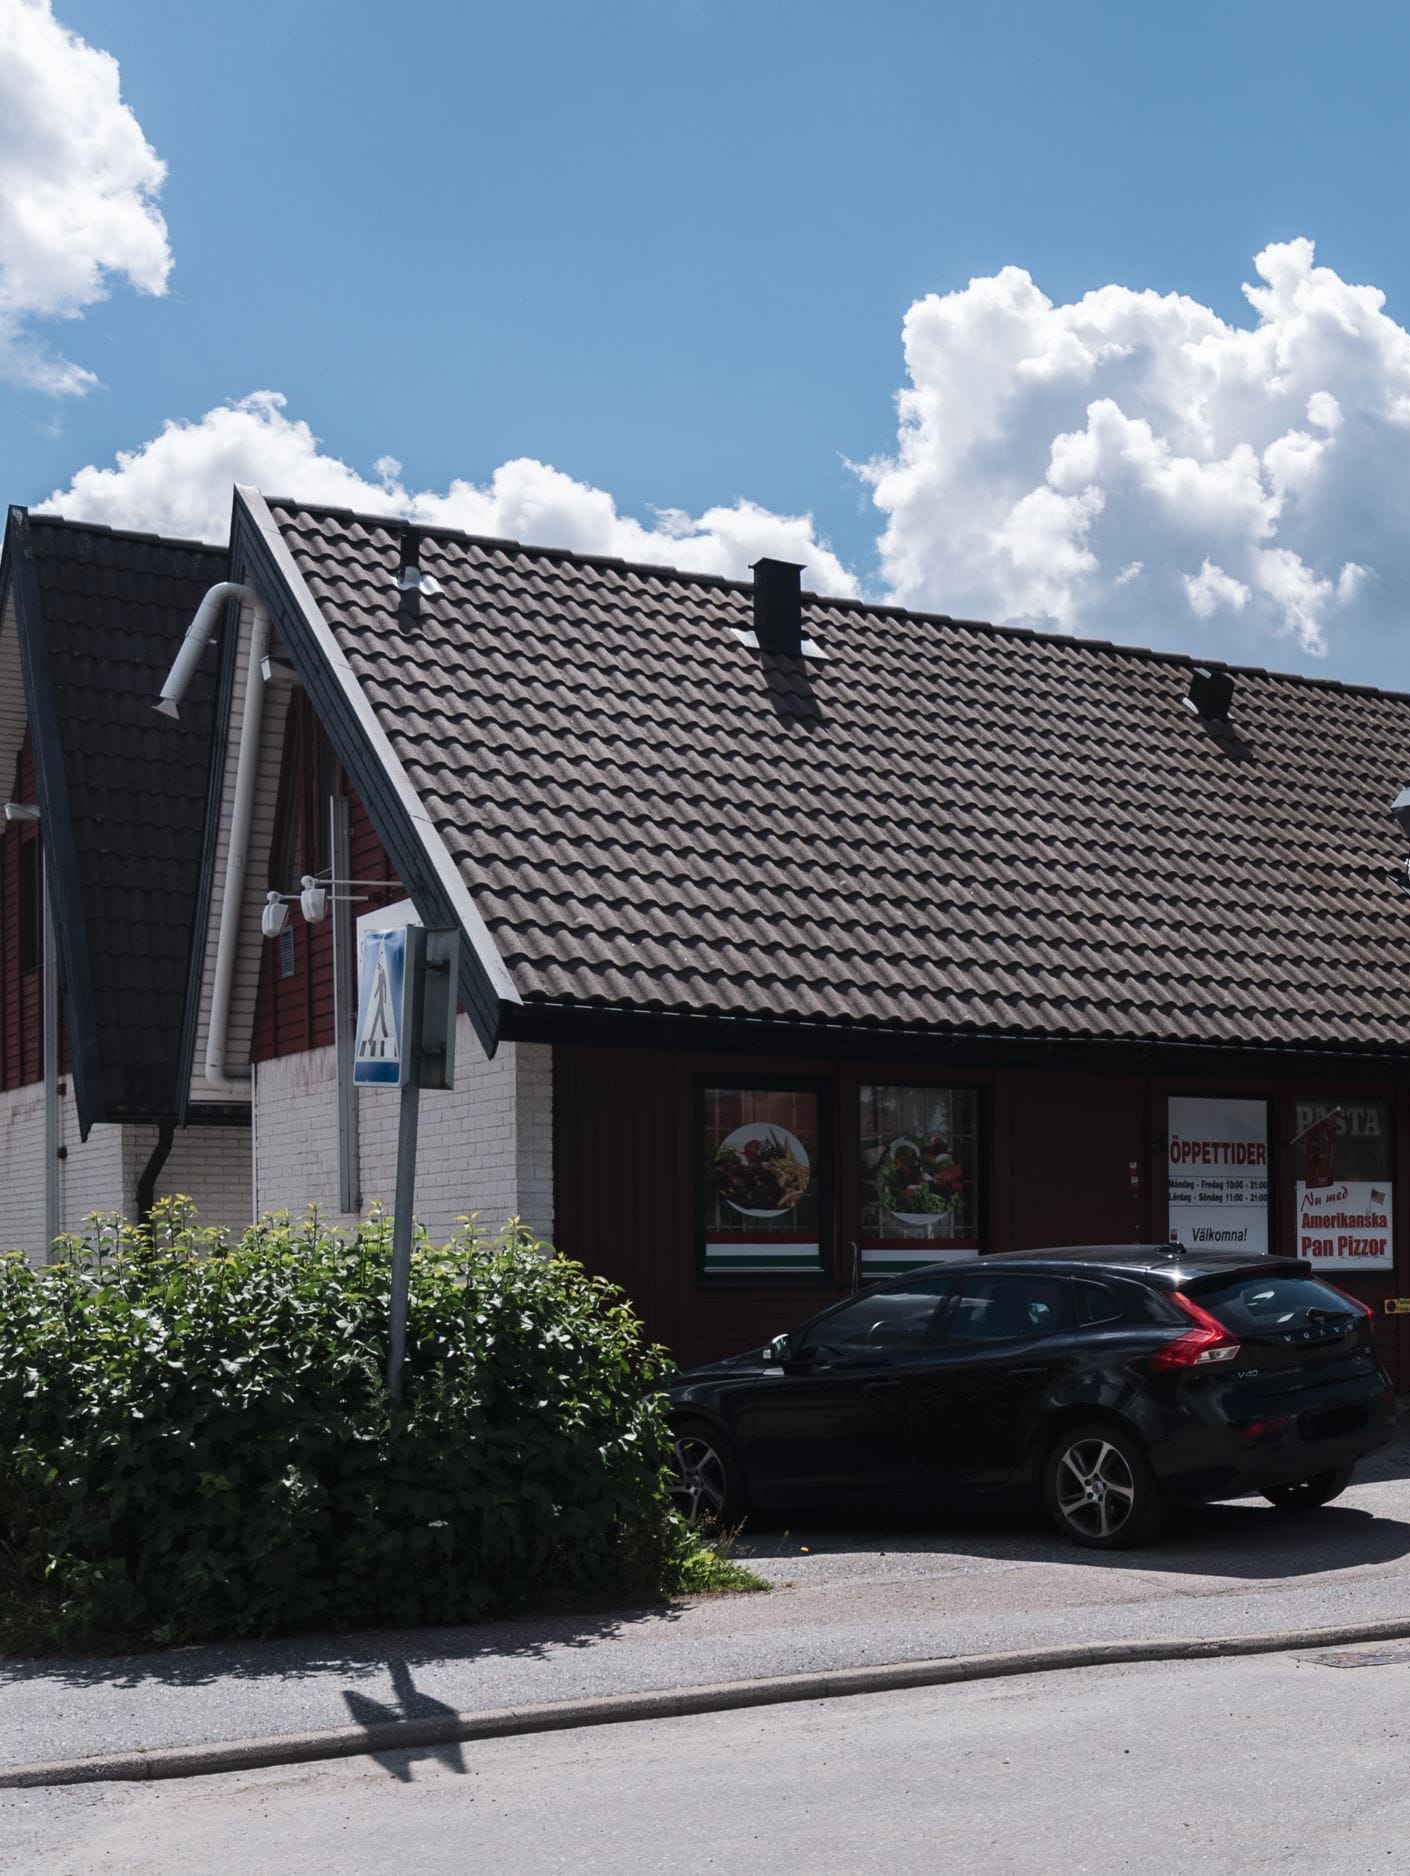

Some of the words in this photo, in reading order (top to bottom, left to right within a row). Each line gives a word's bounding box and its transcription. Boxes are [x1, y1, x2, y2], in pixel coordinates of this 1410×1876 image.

[1170, 1135, 1266, 1165] ÖPPETTIDER
[1168, 1180, 1194, 1190] Måndag
[1201, 1180, 1223, 1190] Fredag
[1226, 1181, 1243, 1189] 10:00
[1168, 1193, 1191, 1202] Lördag
[1199, 1193, 1223, 1203] Söndag
[1226, 1193, 1243, 1202] 11:00
[1301, 1192, 1322, 1212] Nu
[1326, 1186, 1348, 1203] med
[1302, 1212, 1388, 1229] Amerikanska
[1192, 1227, 1248, 1242] Välkomna!
[1302, 1236, 1334, 1257] Pan
[1338, 1235, 1387, 1257] Pizzor
[1283, 1320, 1354, 1342] VOLVO
[1237, 1369, 1259, 1379] V40
